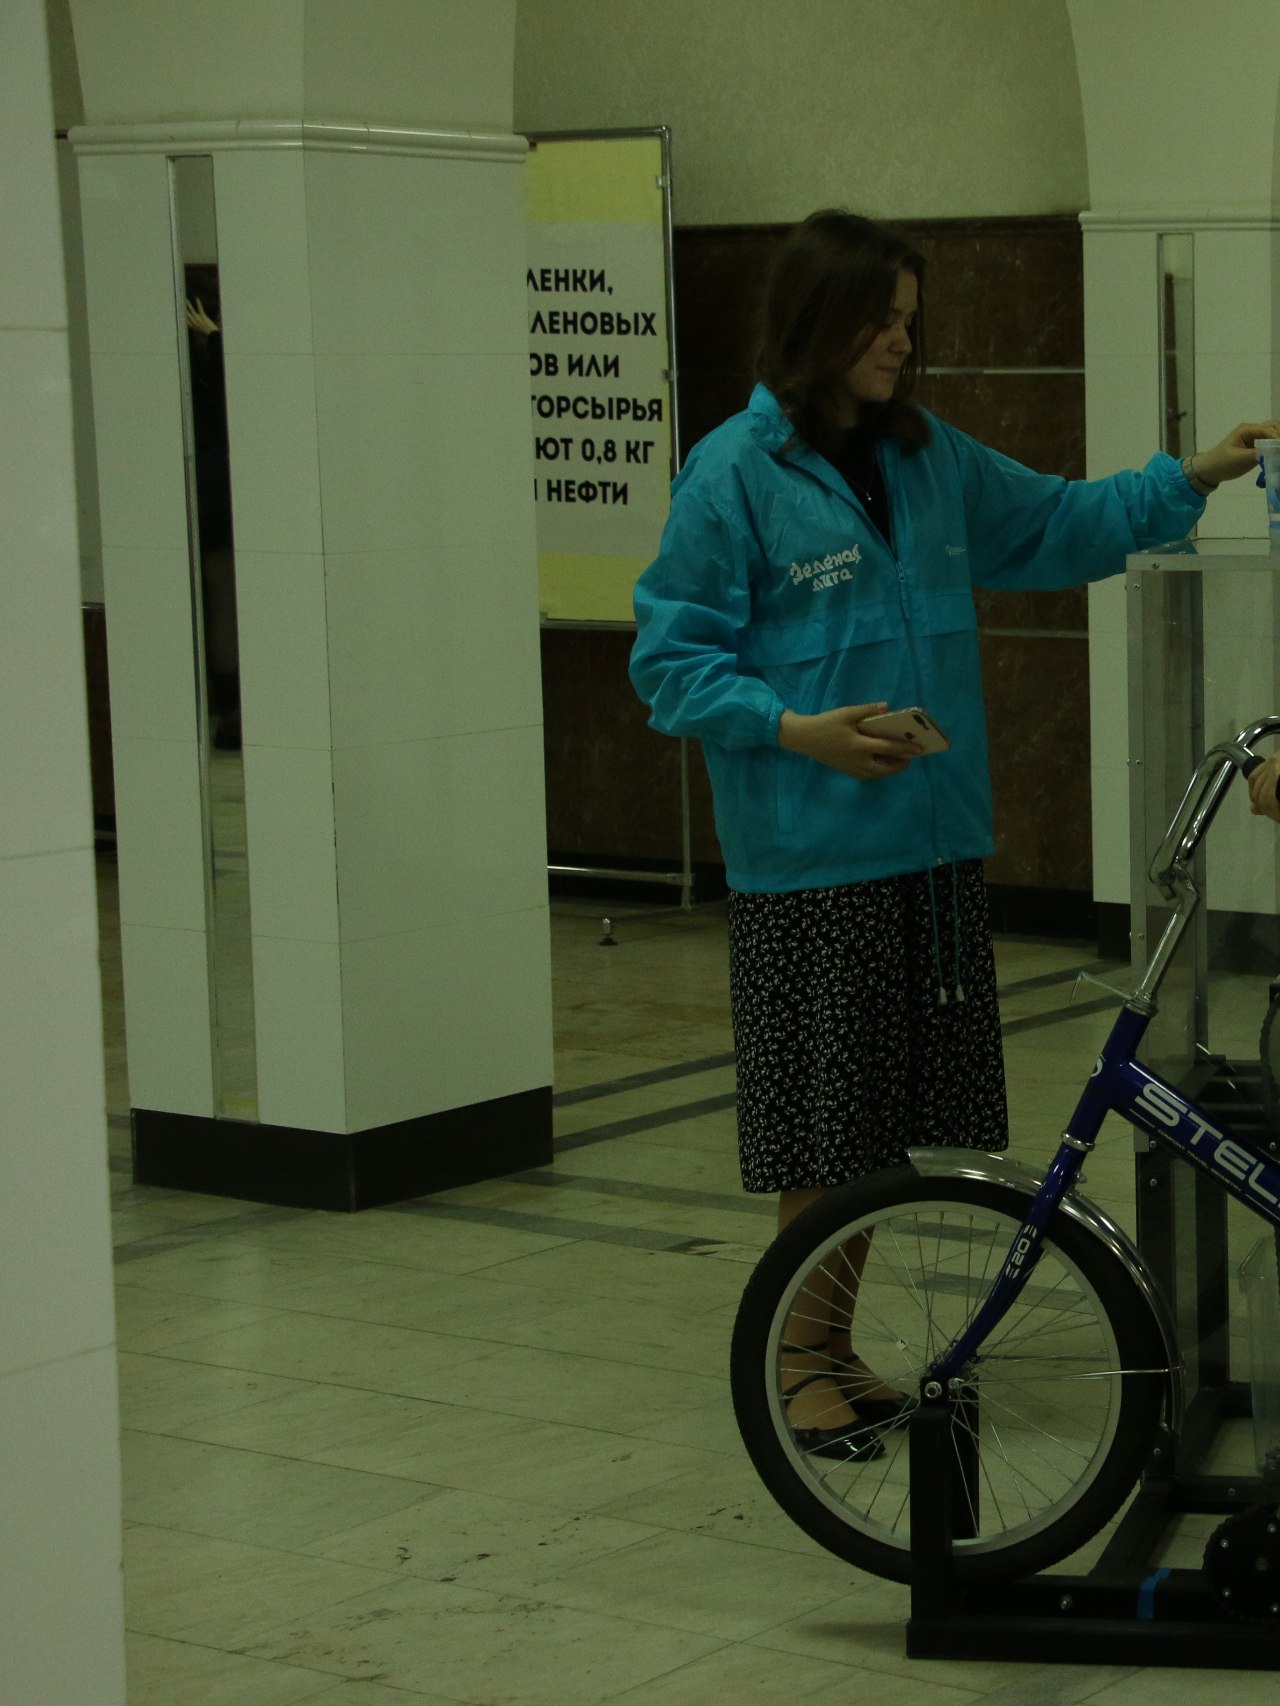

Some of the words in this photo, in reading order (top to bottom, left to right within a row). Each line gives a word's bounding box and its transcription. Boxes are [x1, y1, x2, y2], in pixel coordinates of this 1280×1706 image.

[527, 268, 613, 295] ЛЕНКИ,
[530, 310, 657, 336] ЛЕНОВЫХ
[568, 353, 620, 378] ИЛИ
[535, 437, 573, 461] ЮТ
[581, 438, 617, 465] 0,8
[626, 440, 654, 464] КГ
[547, 479, 628, 505] НЕФТИ
[1010, 1237, 1031, 1266] 20
